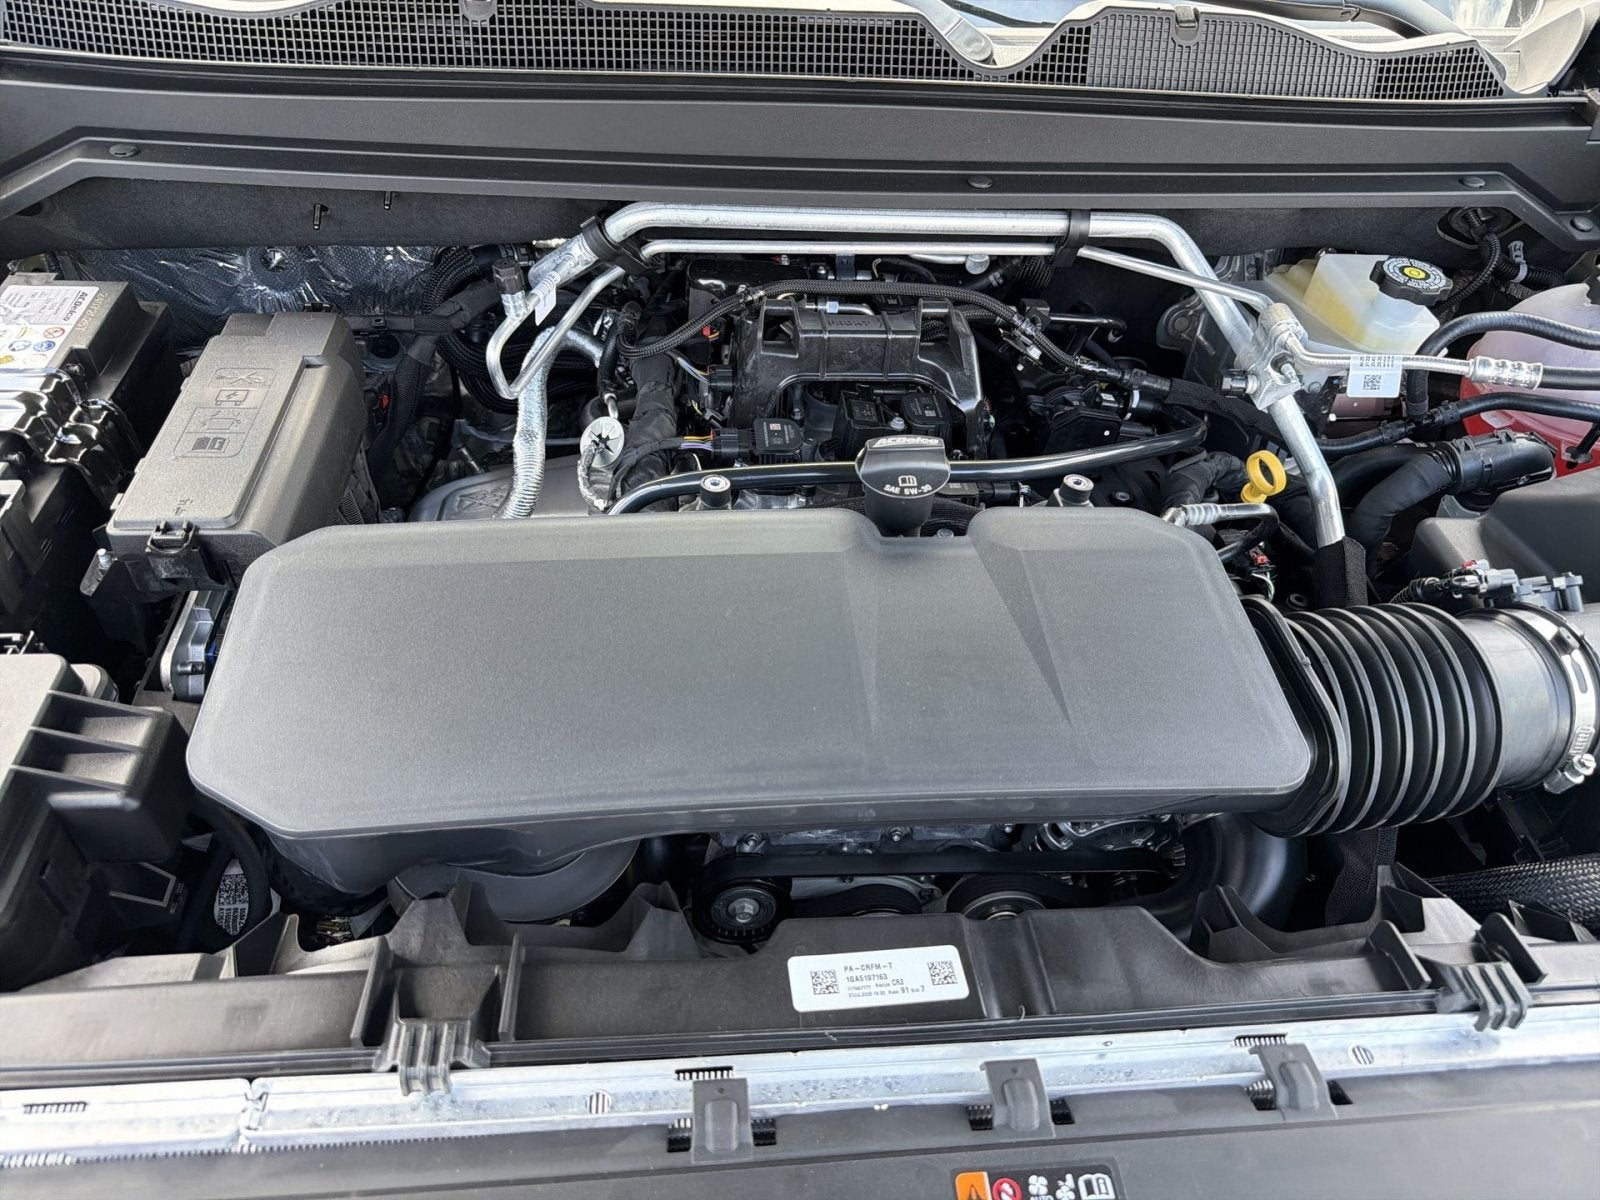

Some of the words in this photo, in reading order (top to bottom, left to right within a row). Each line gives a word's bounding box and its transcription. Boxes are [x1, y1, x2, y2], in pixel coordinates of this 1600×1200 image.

[62, 291, 88, 321] ACDelco
[872, 437, 939, 447] ACDelco
[883, 484, 900, 494] SAE
[904, 484, 932, 495] 5W-30
